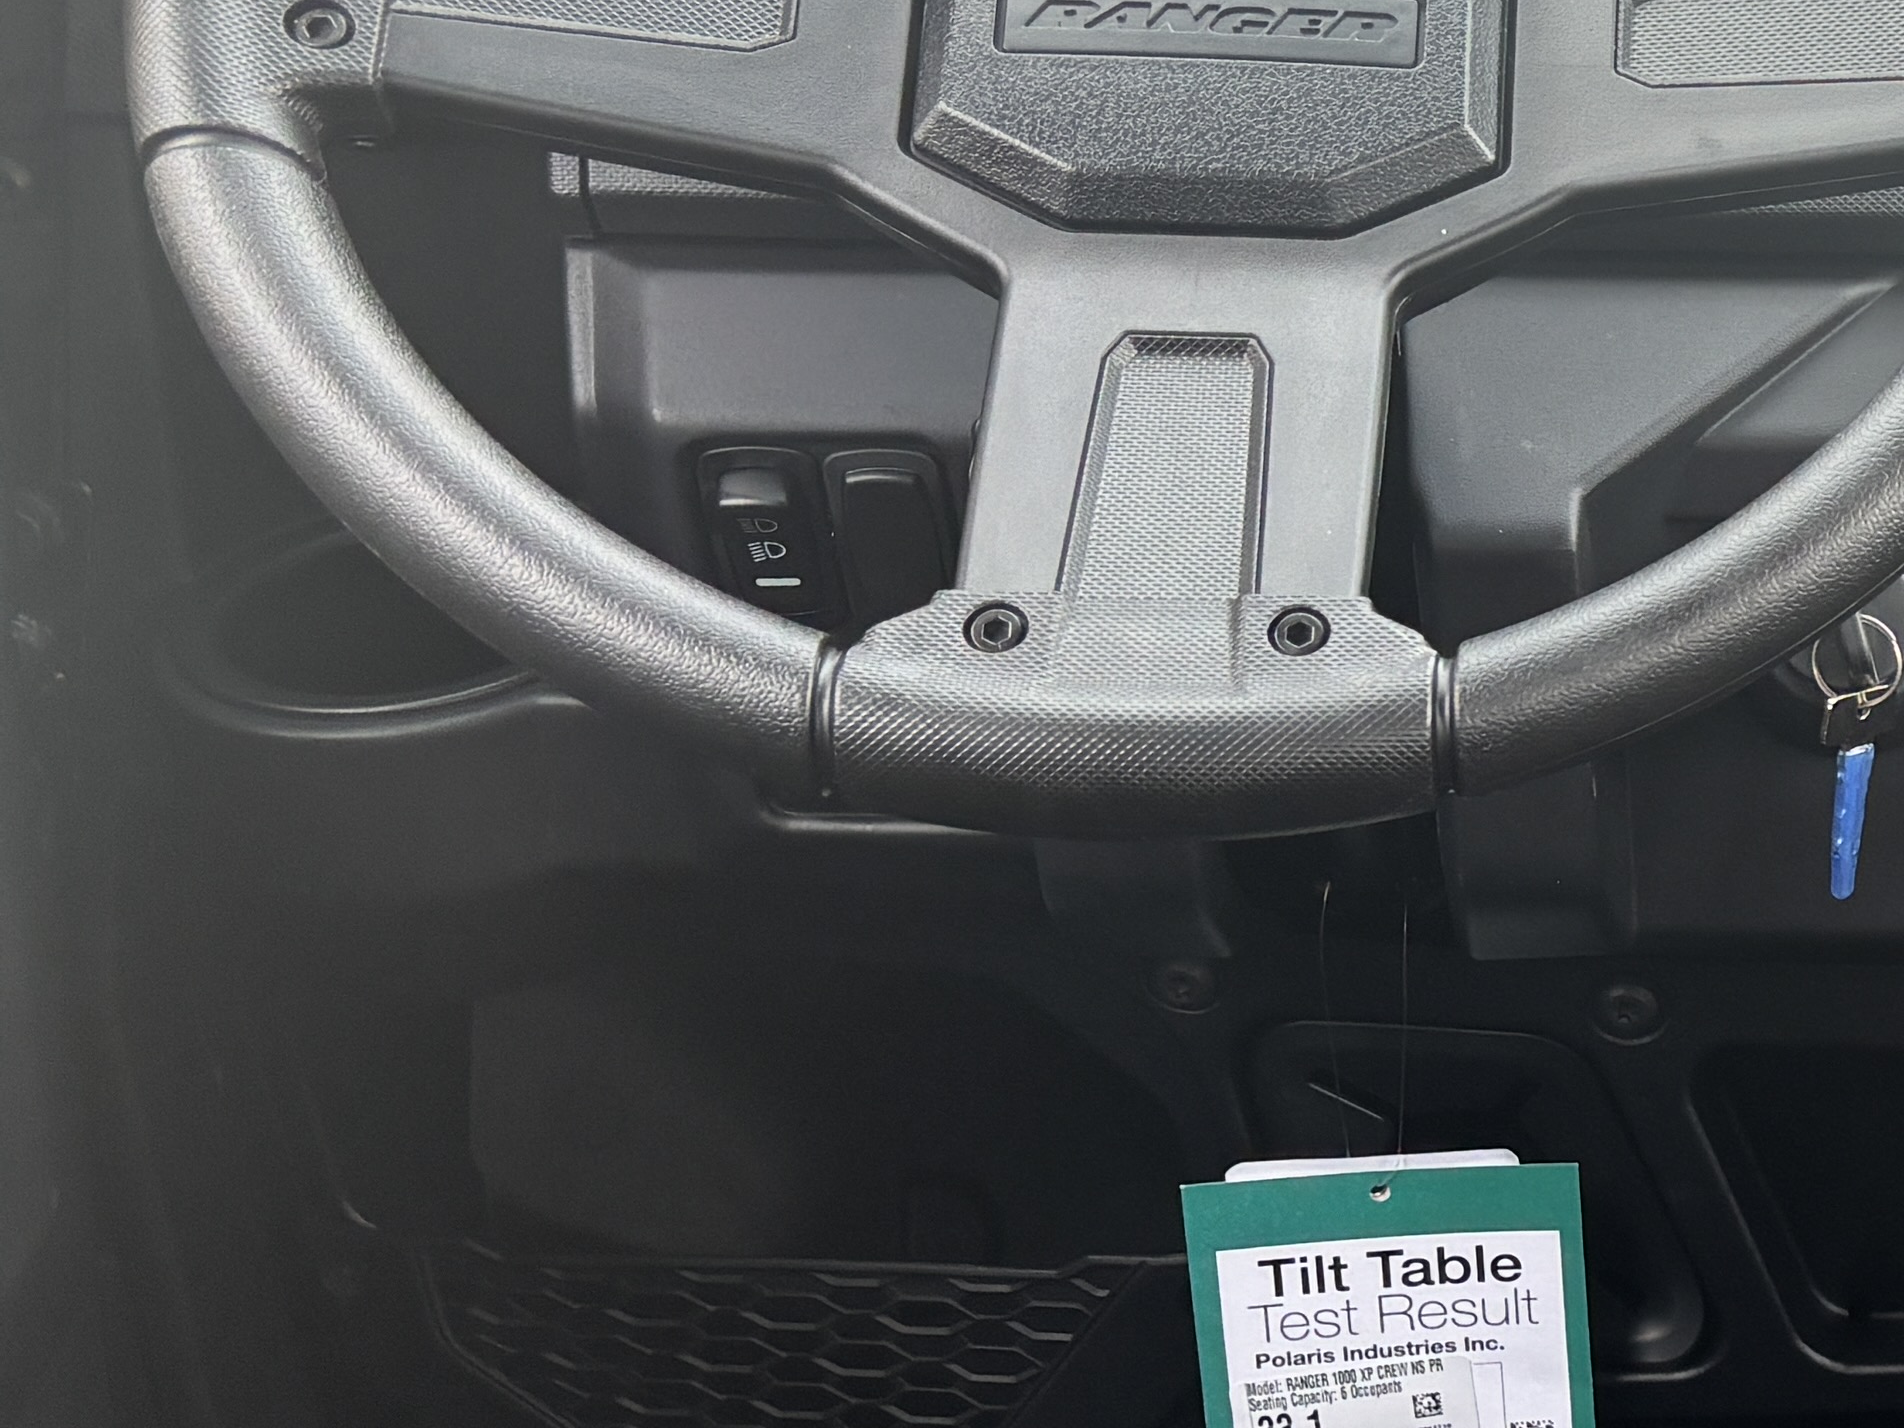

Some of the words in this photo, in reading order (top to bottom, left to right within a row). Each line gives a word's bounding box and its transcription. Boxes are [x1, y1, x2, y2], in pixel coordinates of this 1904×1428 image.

[1257, 1255, 1350, 1297] Tilt
[1366, 1245, 1522, 1288] Table
[1247, 1300, 1359, 1343] Test
[1378, 1287, 1539, 1333] Result
[1256, 1349, 1335, 1369] Polaris
[1343, 1340, 1457, 1361] Industries
[1464, 1337, 1504, 1352] Inc.
[1286, 1373, 1328, 1390] RANGER
[1332, 1369, 1357, 1385] 1000
[1359, 1367, 1373, 1380] XP
[1377, 1363, 1407, 1378] CREW
[1411, 1360, 1425, 1374] NS
[1429, 1358, 1443, 1372] PR
[1248, 1395, 1287, 1412] Seating
[1290, 1390, 1337, 1407] Capacity:
[1340, 1386, 1347, 1399] 6
